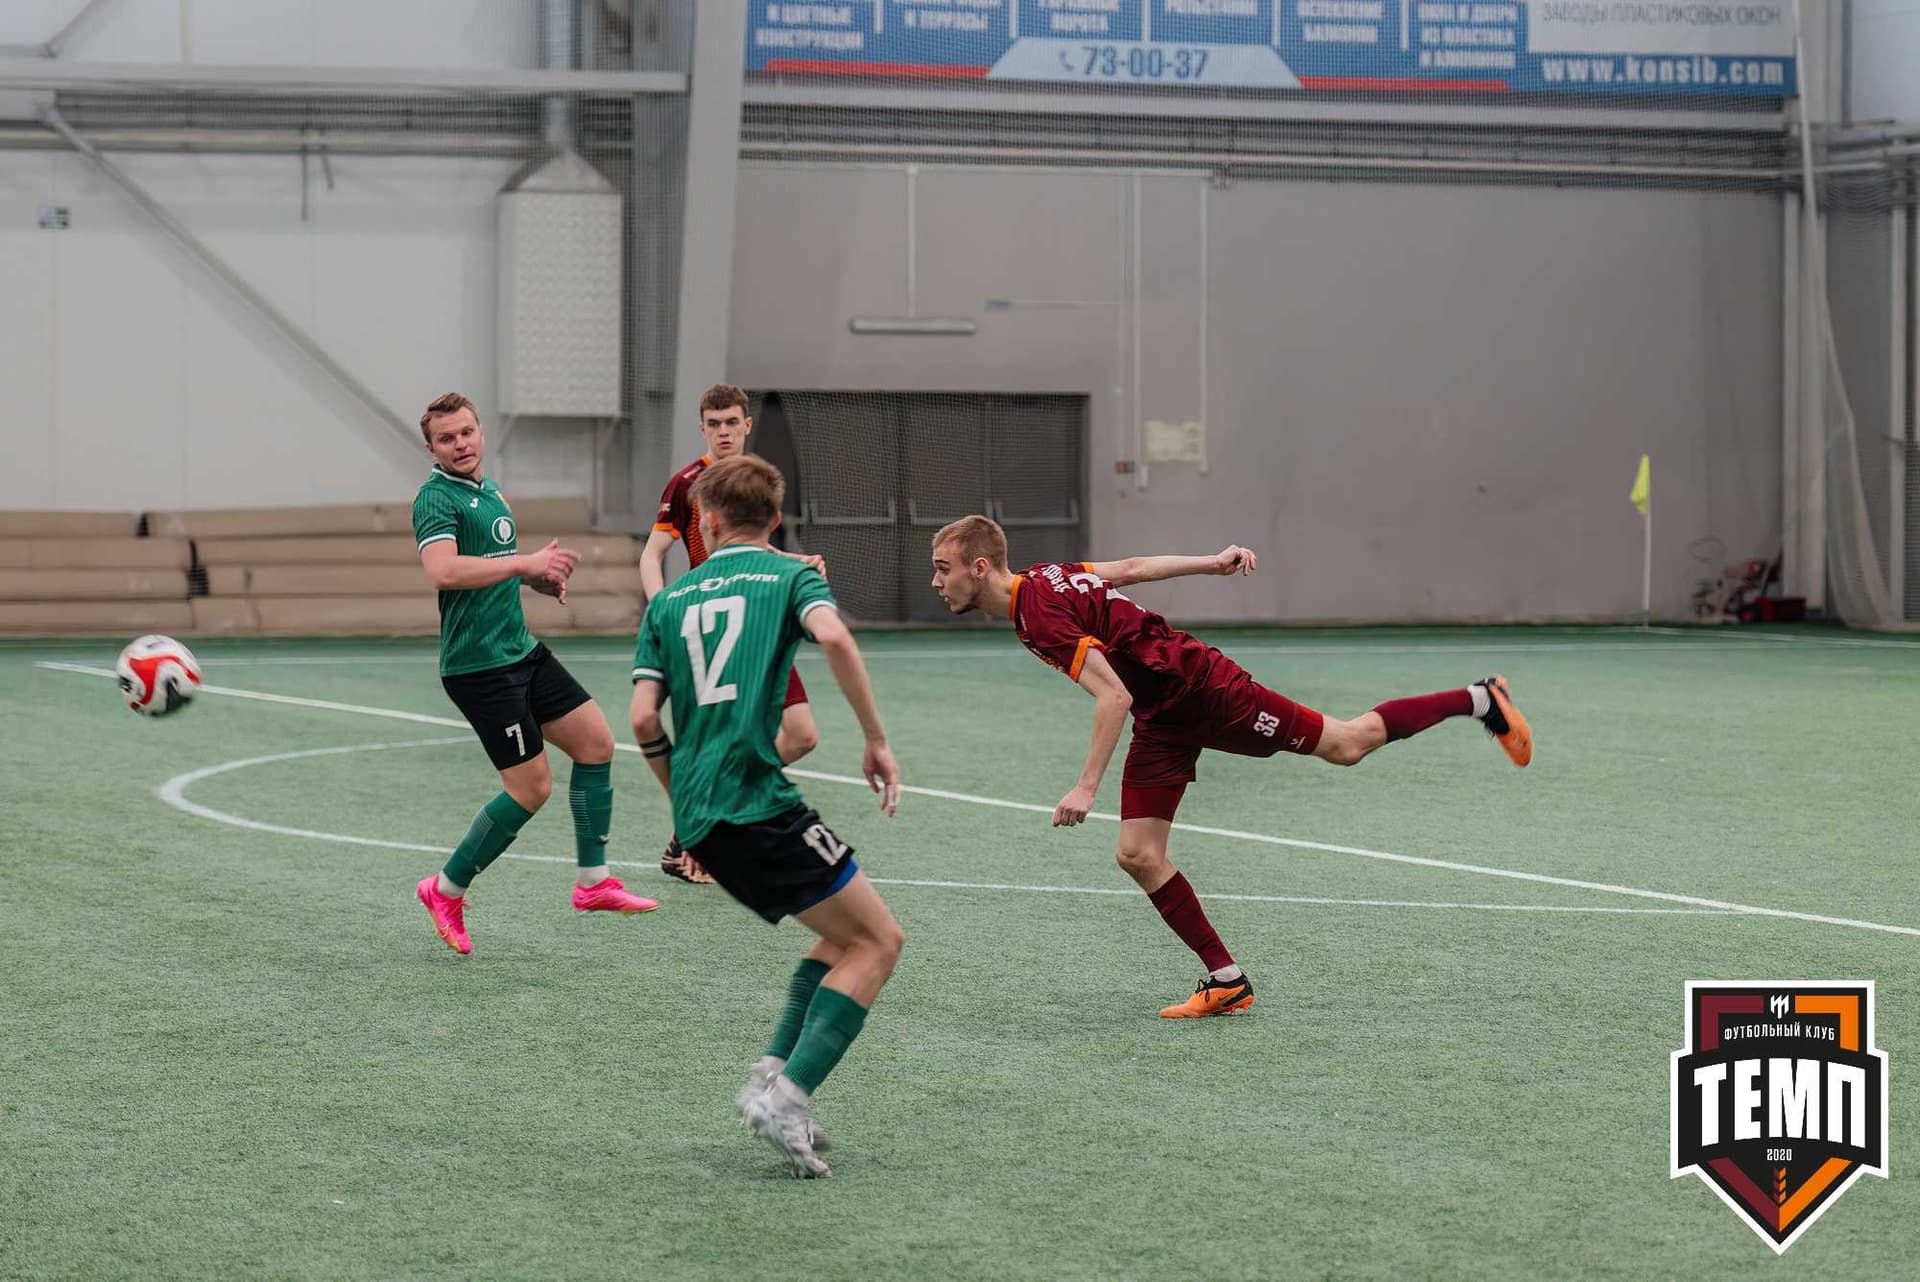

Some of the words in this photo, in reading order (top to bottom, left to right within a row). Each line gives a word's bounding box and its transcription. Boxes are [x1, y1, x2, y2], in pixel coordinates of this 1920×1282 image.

[1737, 7, 1782, 24] ОКОН
[1083, 46, 1209, 79] 73-00-37
[1543, 56, 1784, 85] www.konsib.com
[680, 595, 746, 706] 12
[505, 723, 525, 757] 7
[1253, 711, 1280, 737] 33
[803, 824, 849, 866] 12
